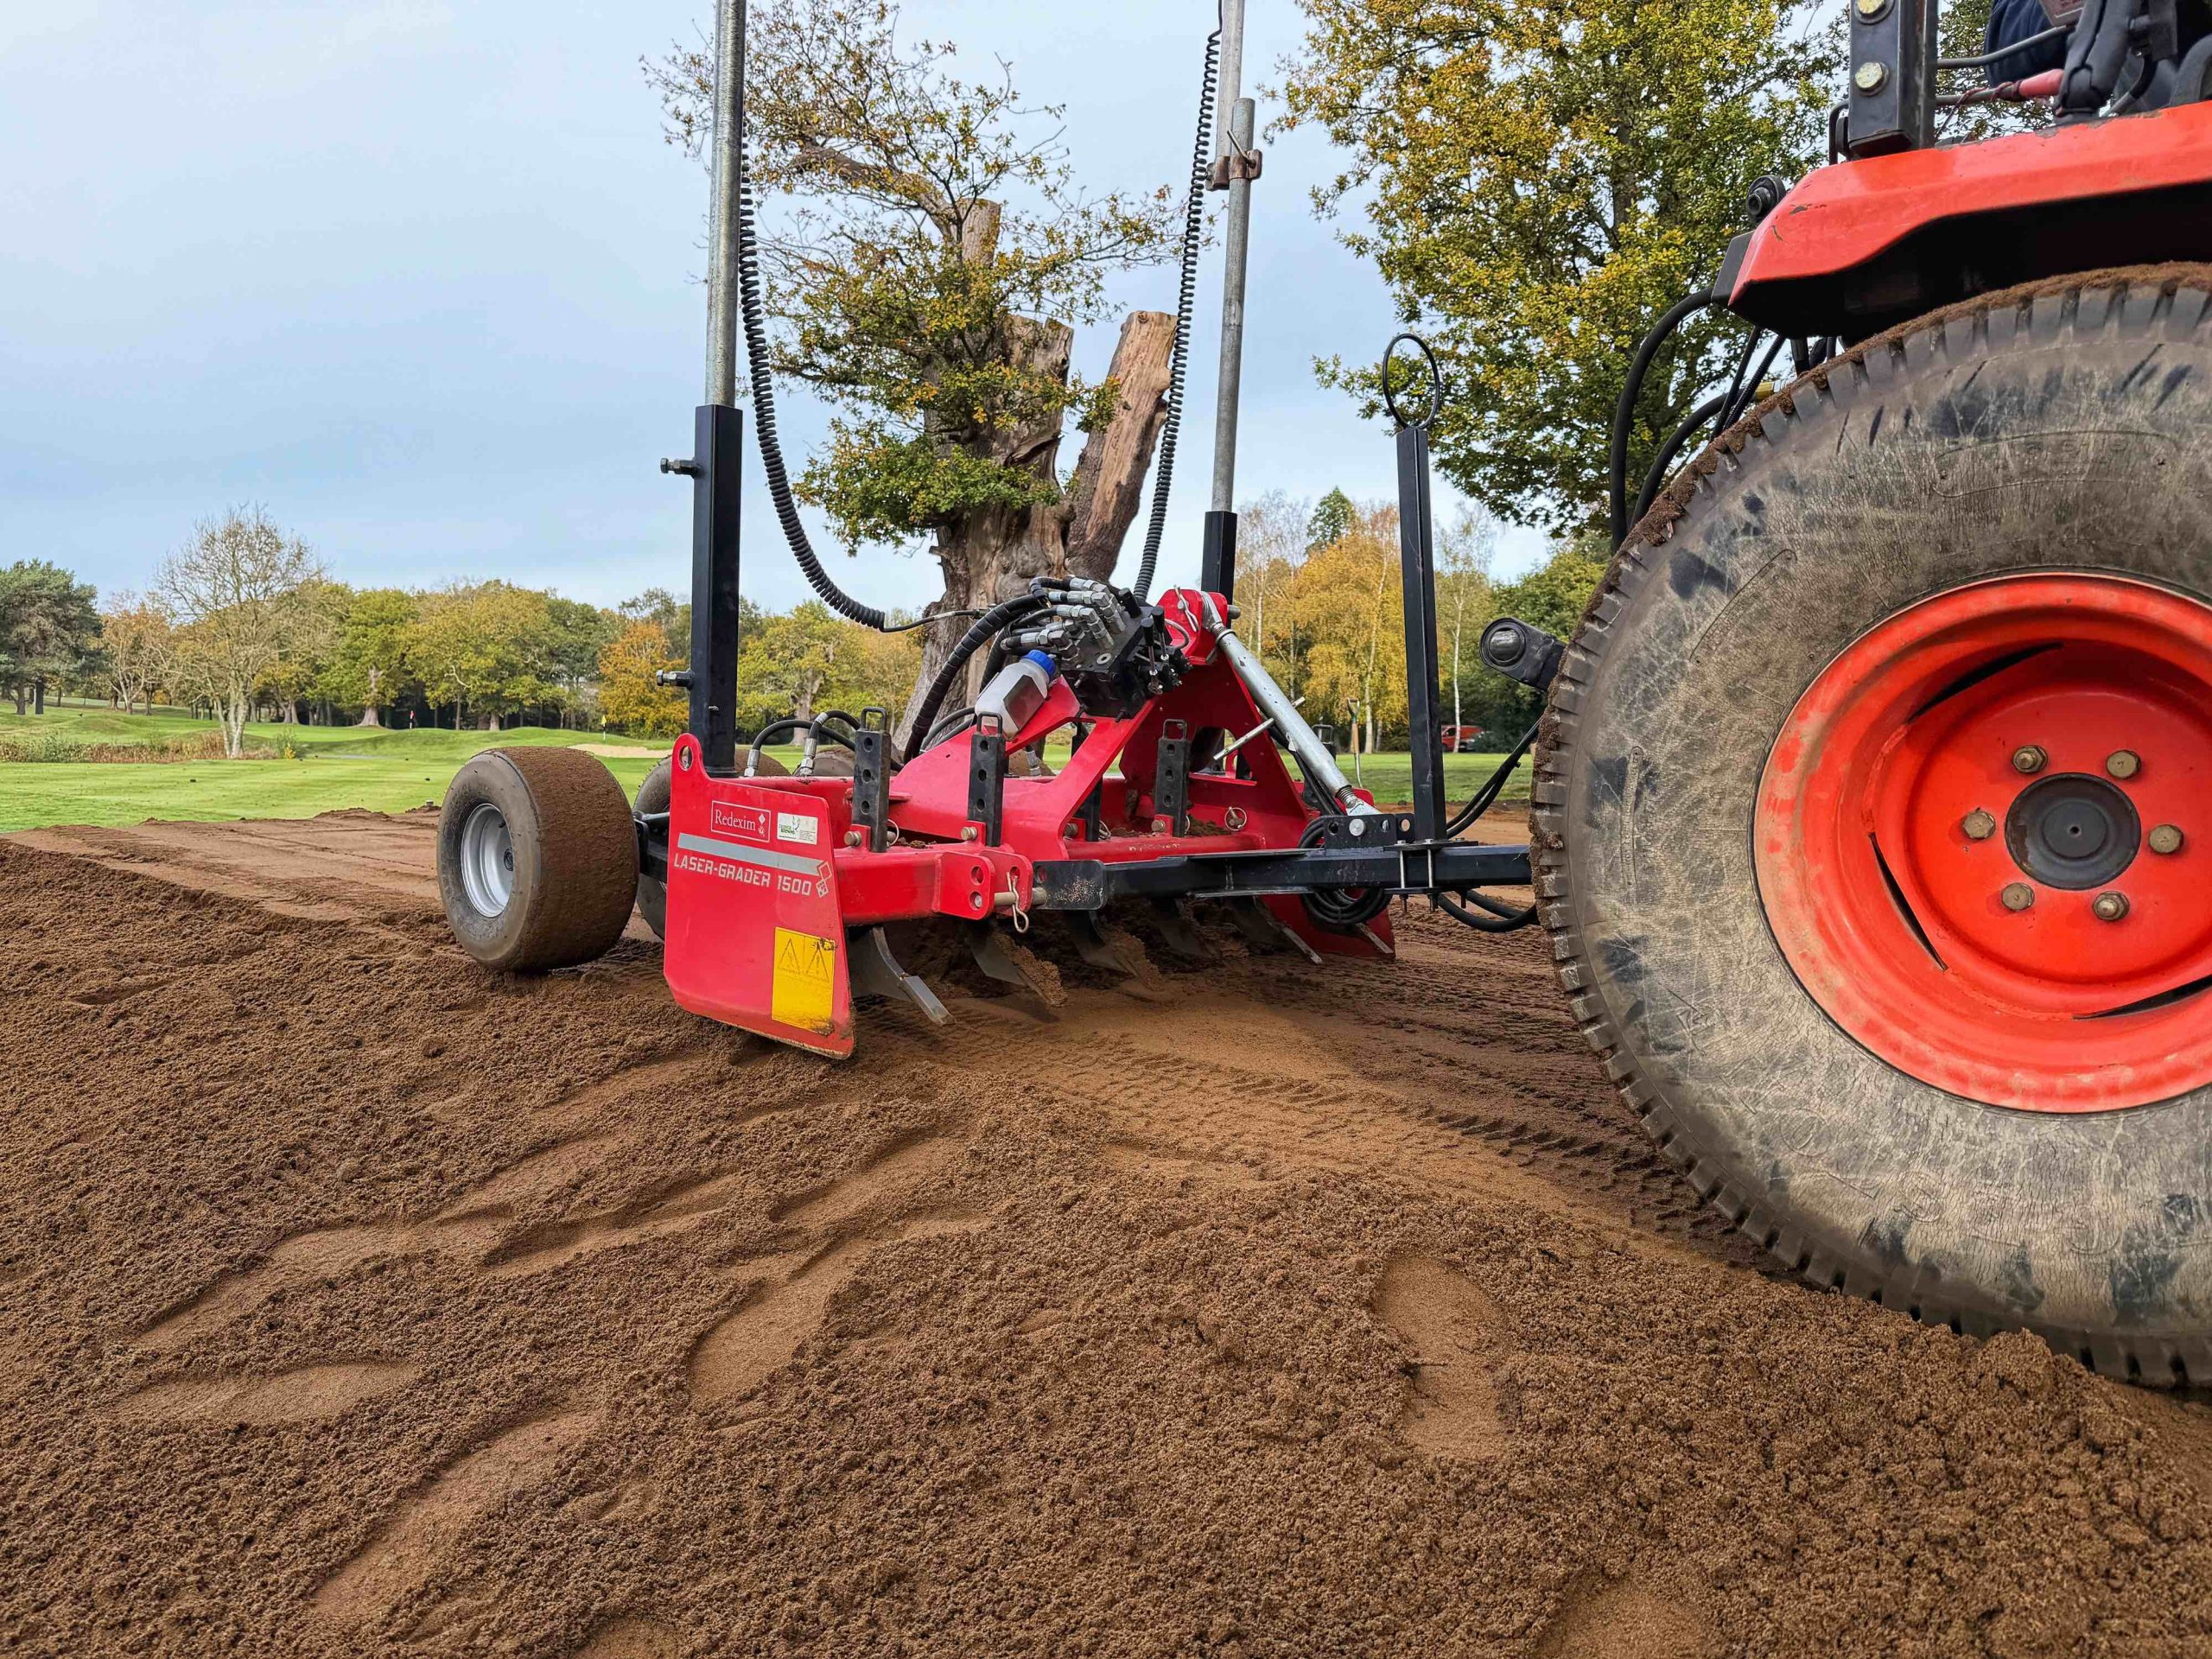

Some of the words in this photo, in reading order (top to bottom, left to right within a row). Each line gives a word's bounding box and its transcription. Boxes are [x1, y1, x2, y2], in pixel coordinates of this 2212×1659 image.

[715, 809, 756, 831] Redexim
[673, 853, 771, 887] LASER-GRADER
[777, 875, 812, 896] 1500
